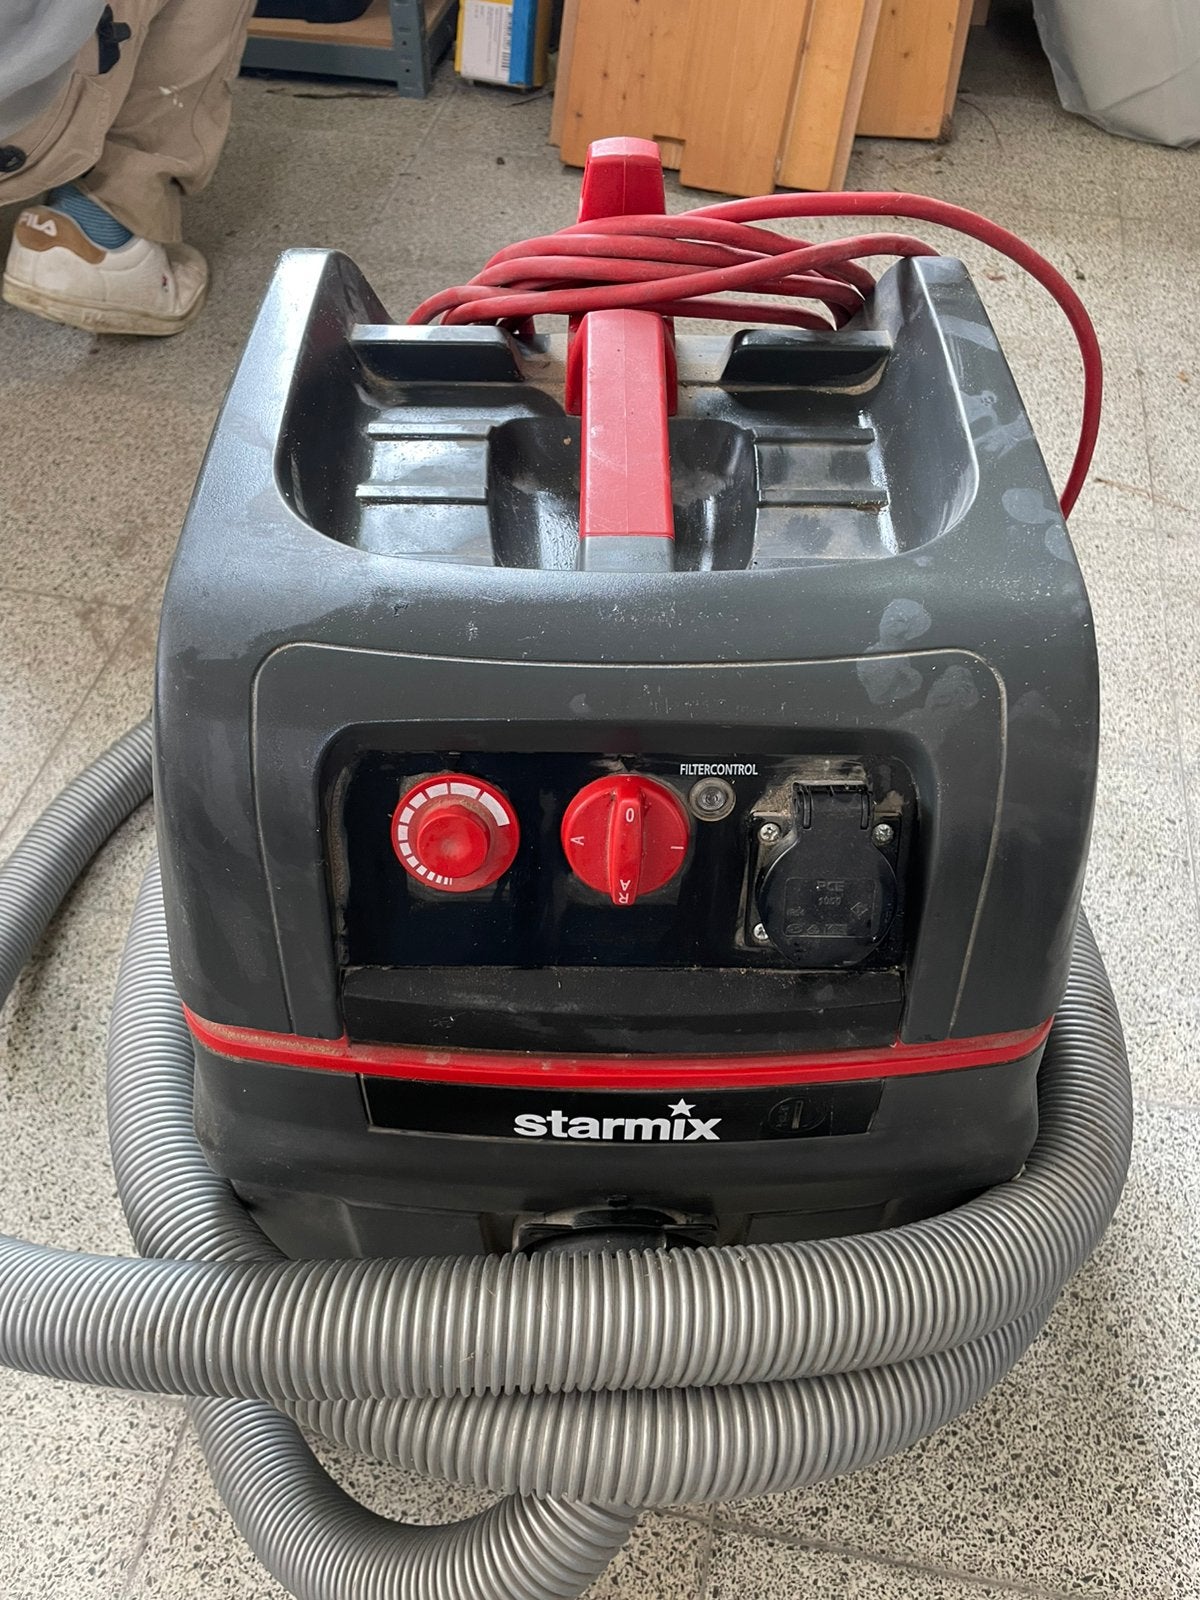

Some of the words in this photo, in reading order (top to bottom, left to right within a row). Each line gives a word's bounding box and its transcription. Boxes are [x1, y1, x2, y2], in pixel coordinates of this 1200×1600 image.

[19, 211, 58, 237] FILA
[680, 763, 759, 776] FILTERCONTROL
[570, 836, 585, 846] A
[816, 880, 845, 892] PCE
[513, 1098, 722, 1141] starmix
